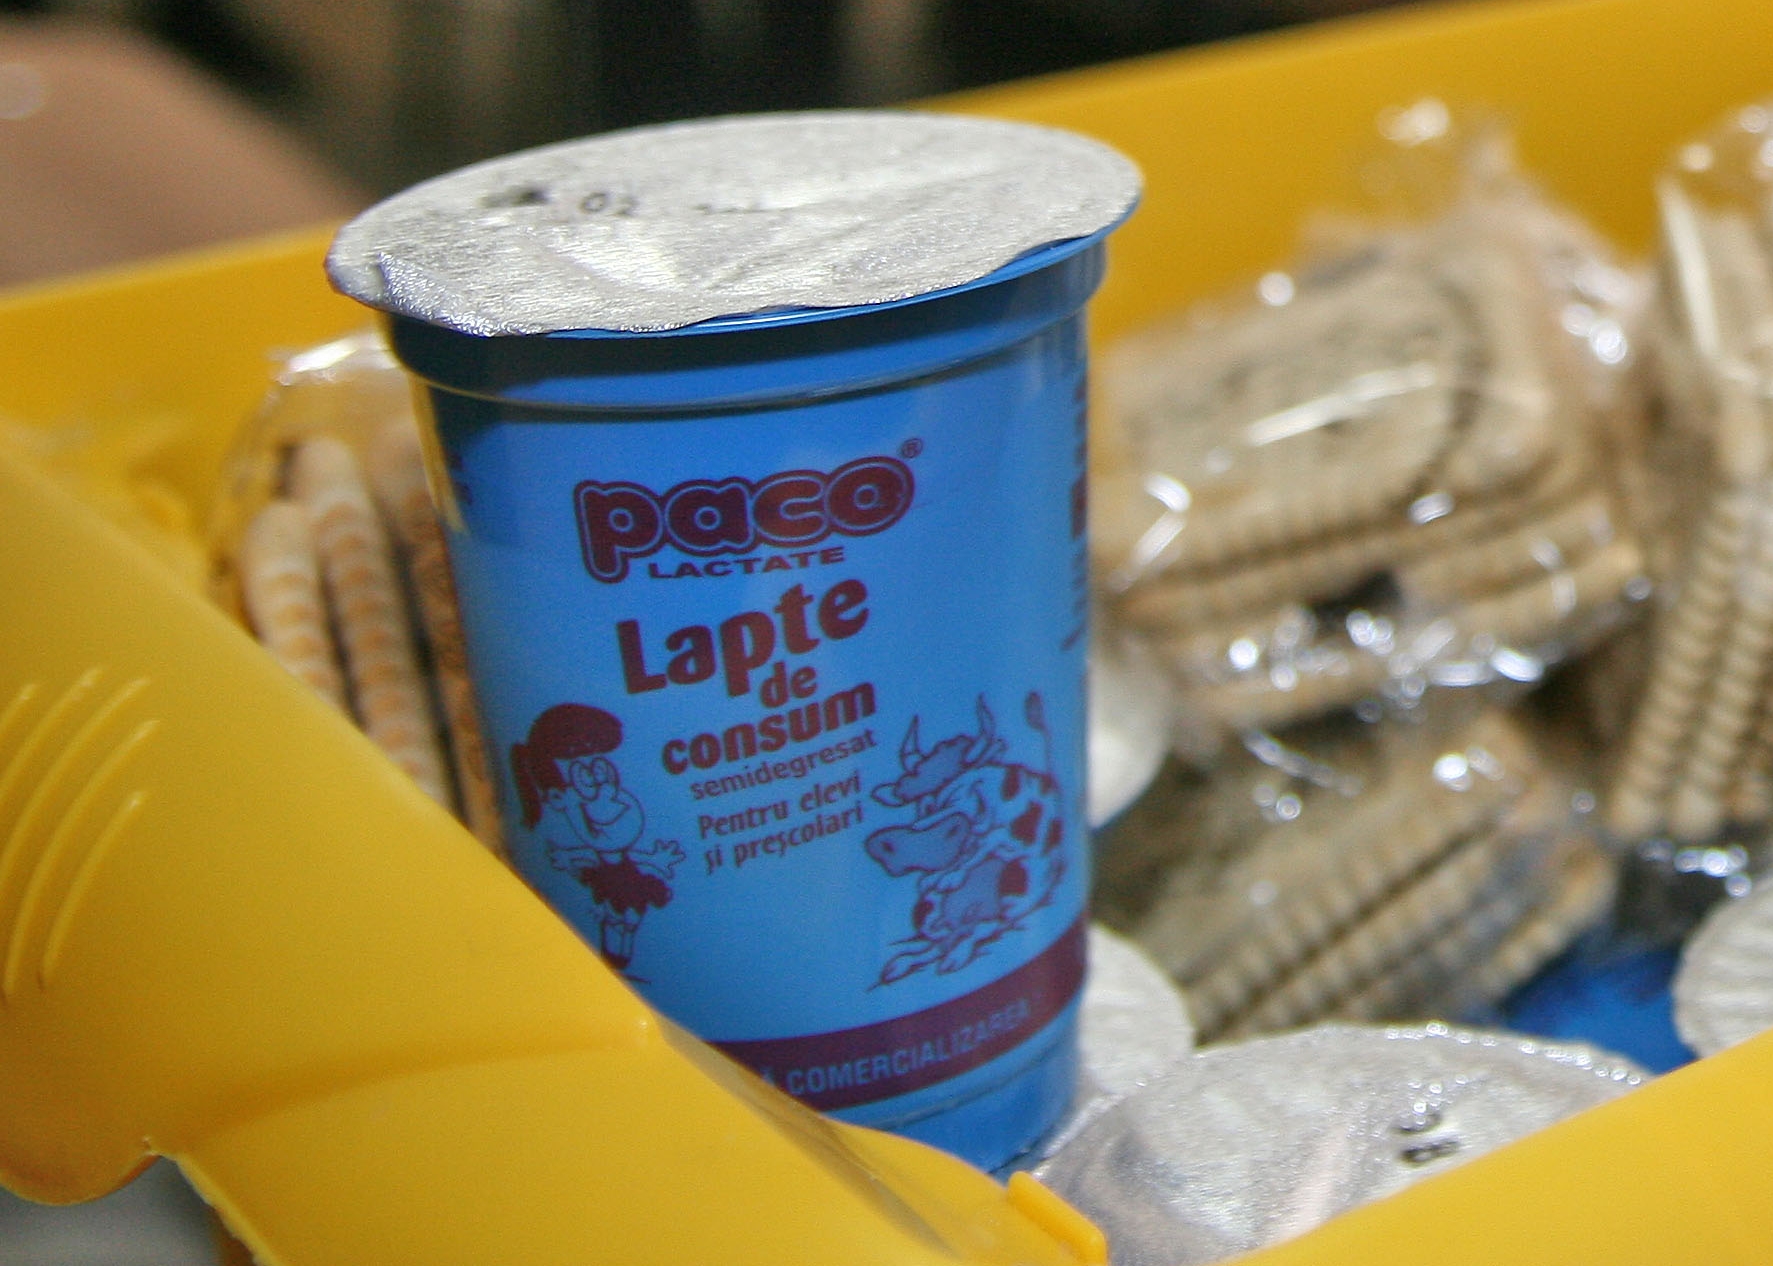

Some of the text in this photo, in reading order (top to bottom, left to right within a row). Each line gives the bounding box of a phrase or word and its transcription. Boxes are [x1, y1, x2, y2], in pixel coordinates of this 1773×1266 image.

[574, 455, 915, 584] paco
[648, 546, 846, 579] LACTATE
[616, 579, 870, 698] Lapte
[759, 660, 818, 709] de
[662, 682, 877, 775] consum
[689, 728, 878, 800] semidegresat
[699, 770, 861, 840] Pentru elevi
